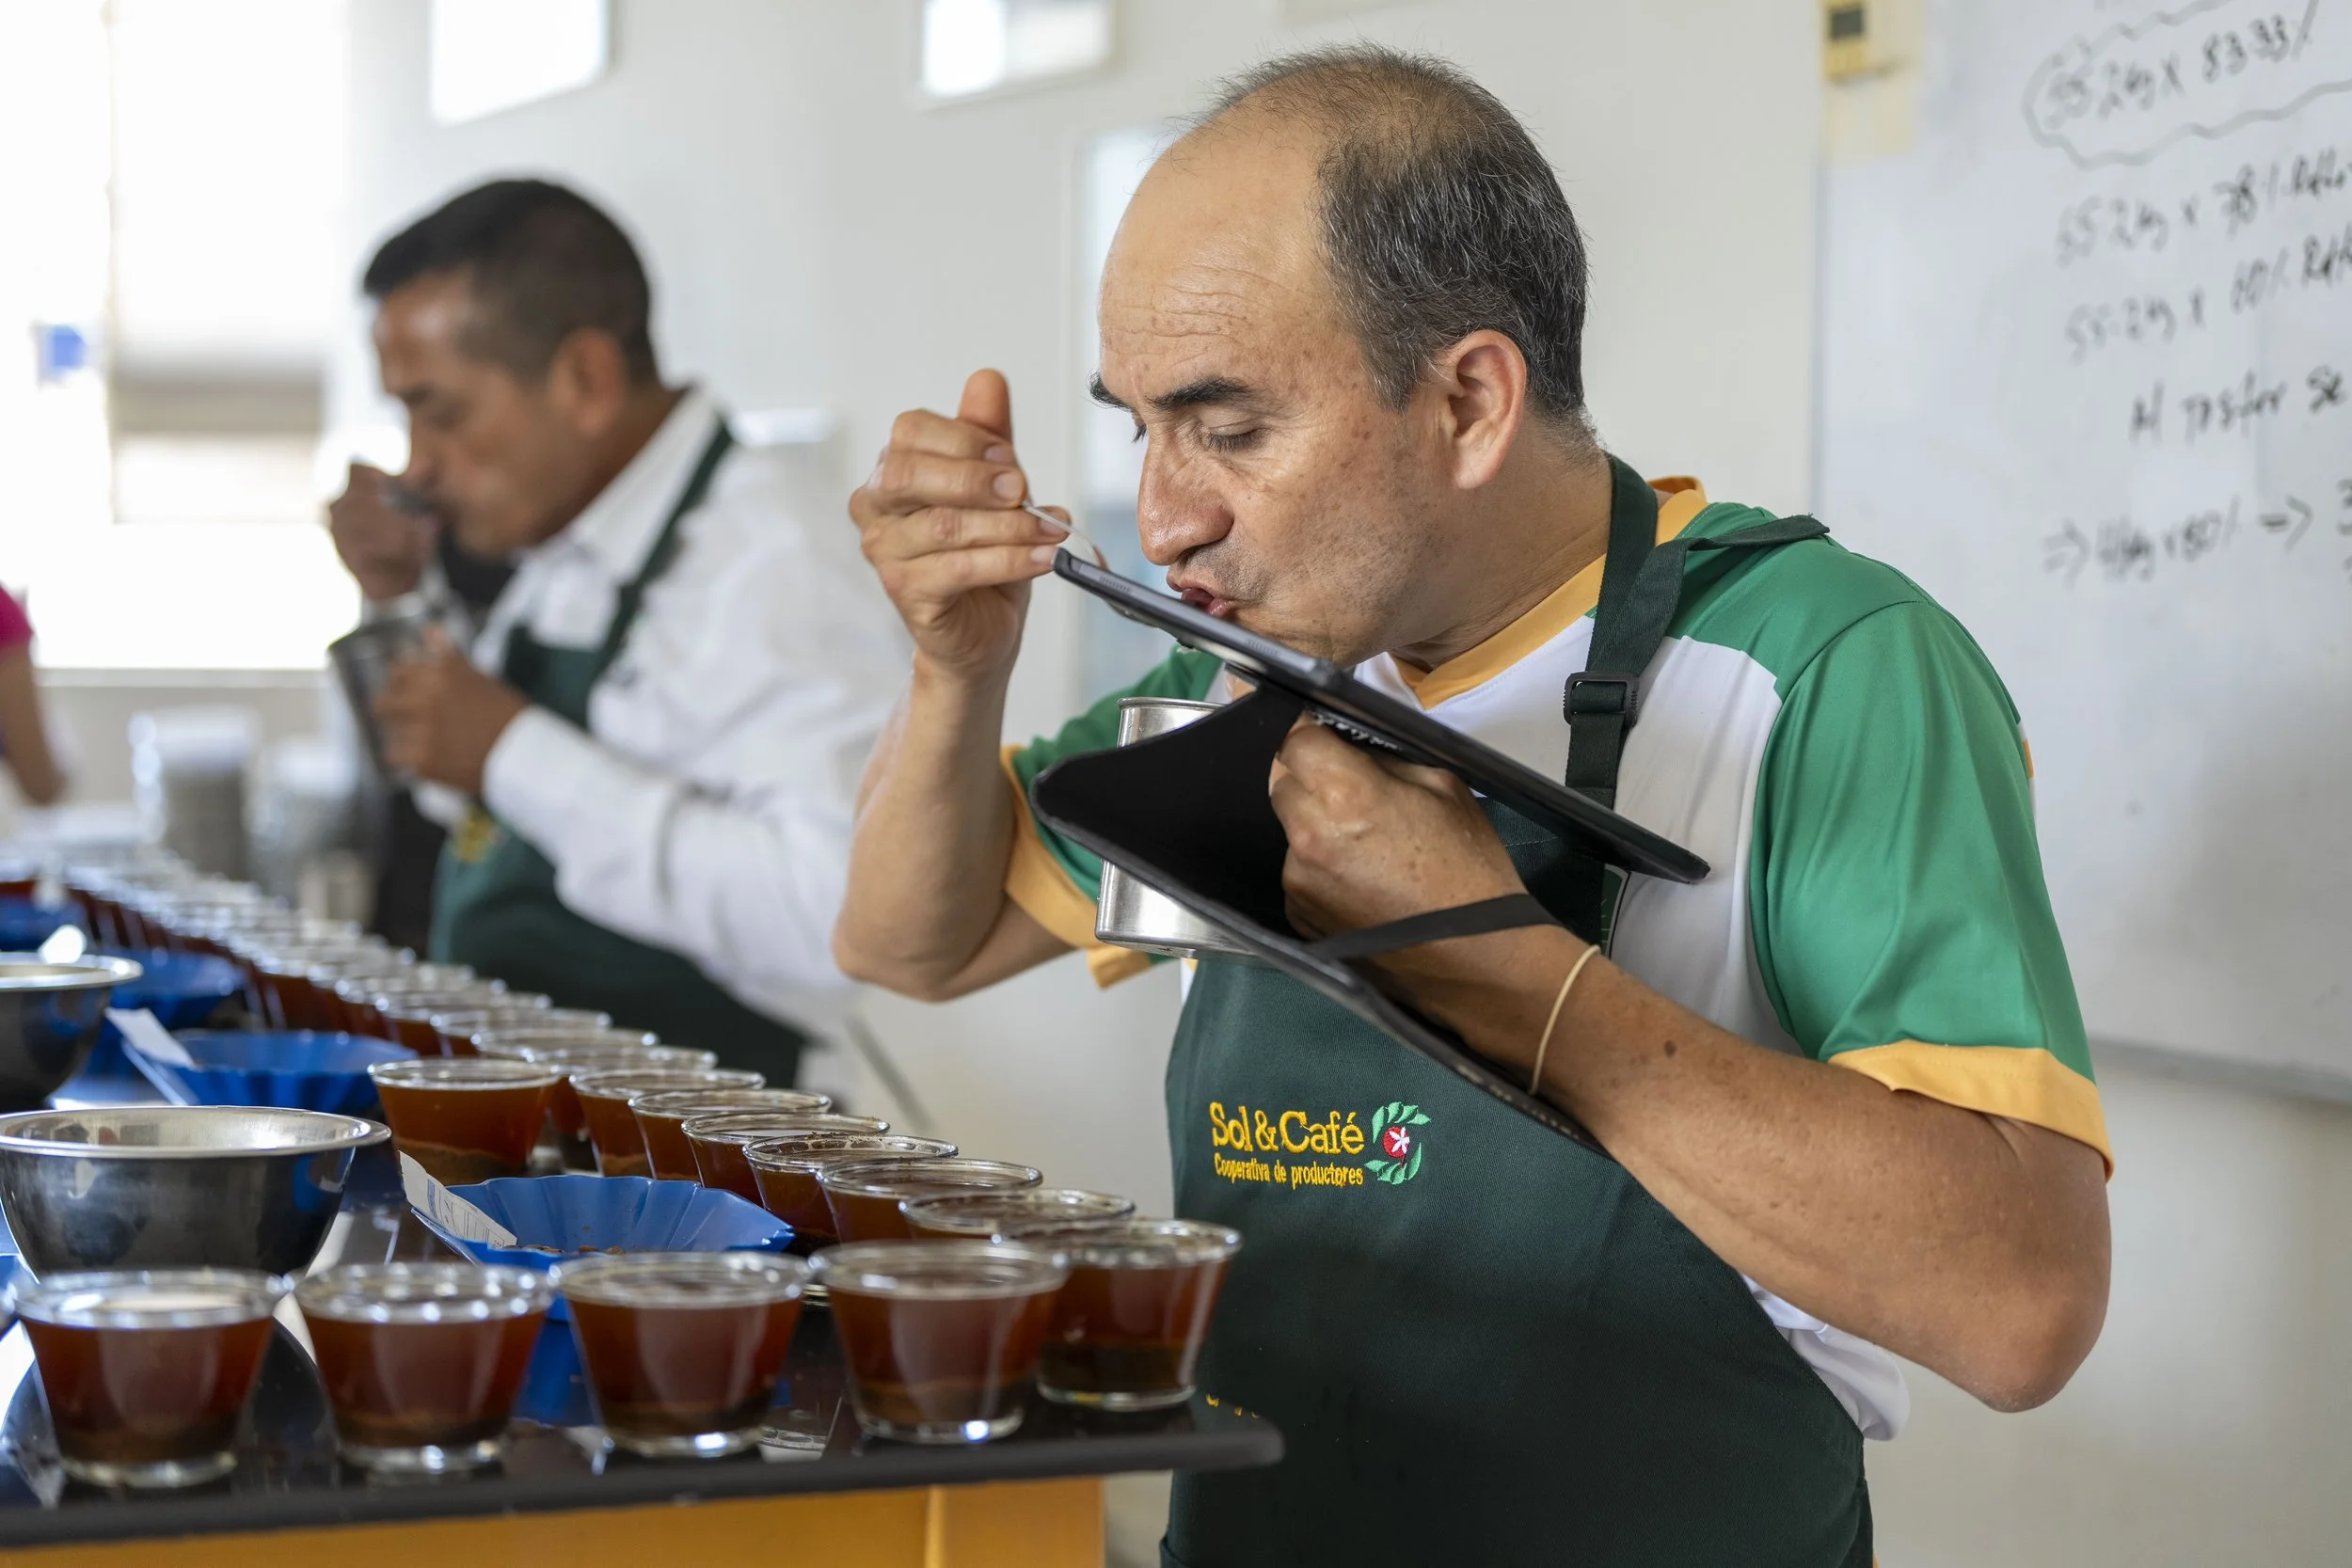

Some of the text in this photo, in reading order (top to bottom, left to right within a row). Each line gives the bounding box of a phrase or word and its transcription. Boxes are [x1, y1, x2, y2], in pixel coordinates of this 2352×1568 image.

[1214, 1152, 1363, 1190] Cooperativa de productores
